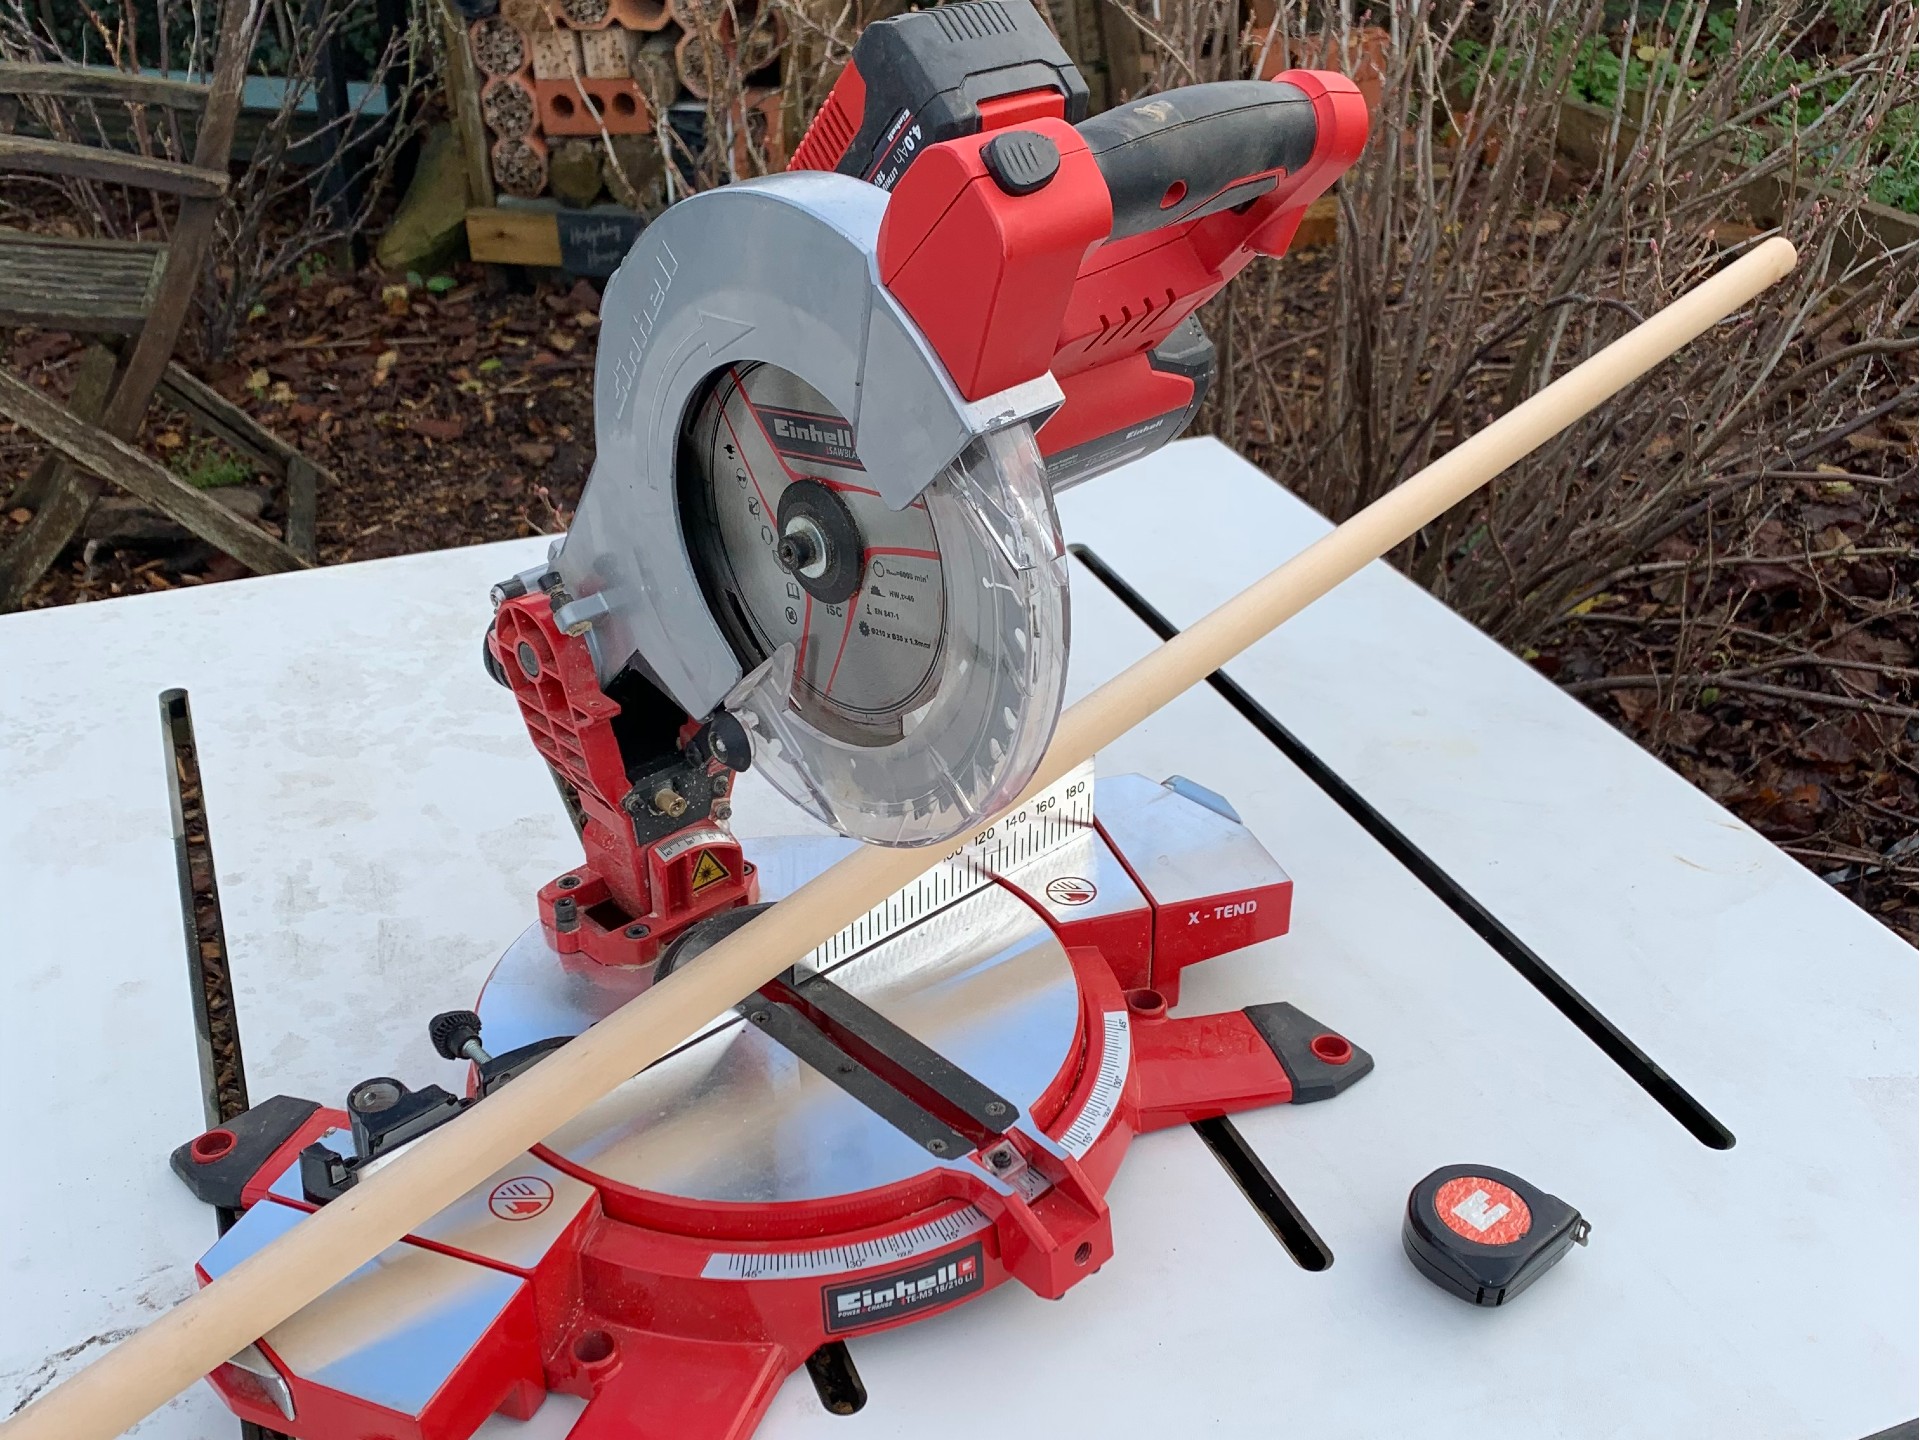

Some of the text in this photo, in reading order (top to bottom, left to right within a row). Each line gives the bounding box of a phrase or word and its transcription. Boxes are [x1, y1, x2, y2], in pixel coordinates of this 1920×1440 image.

[887, 108, 910, 142] Einhell
[773, 418, 852, 448] Einhell
[1126, 419, 1164, 439] Einhell
[828, 446, 859, 459] SAWBLA
[1066, 781, 1085, 799] 180
[1036, 796, 1056, 815] 160
[1005, 811, 1026, 830] 140
[974, 827, 995, 846] 120
[1188, 911, 1200, 925] X
[1214, 900, 1257, 919] TEND
[849, 1259, 866, 1268] 30°
[744, 1269, 762, 1279] 45°
[837, 1262, 957, 1312] Einhell
[906, 1290, 933, 1304] TE-MS
[935, 1277, 964, 1294] 18/210
